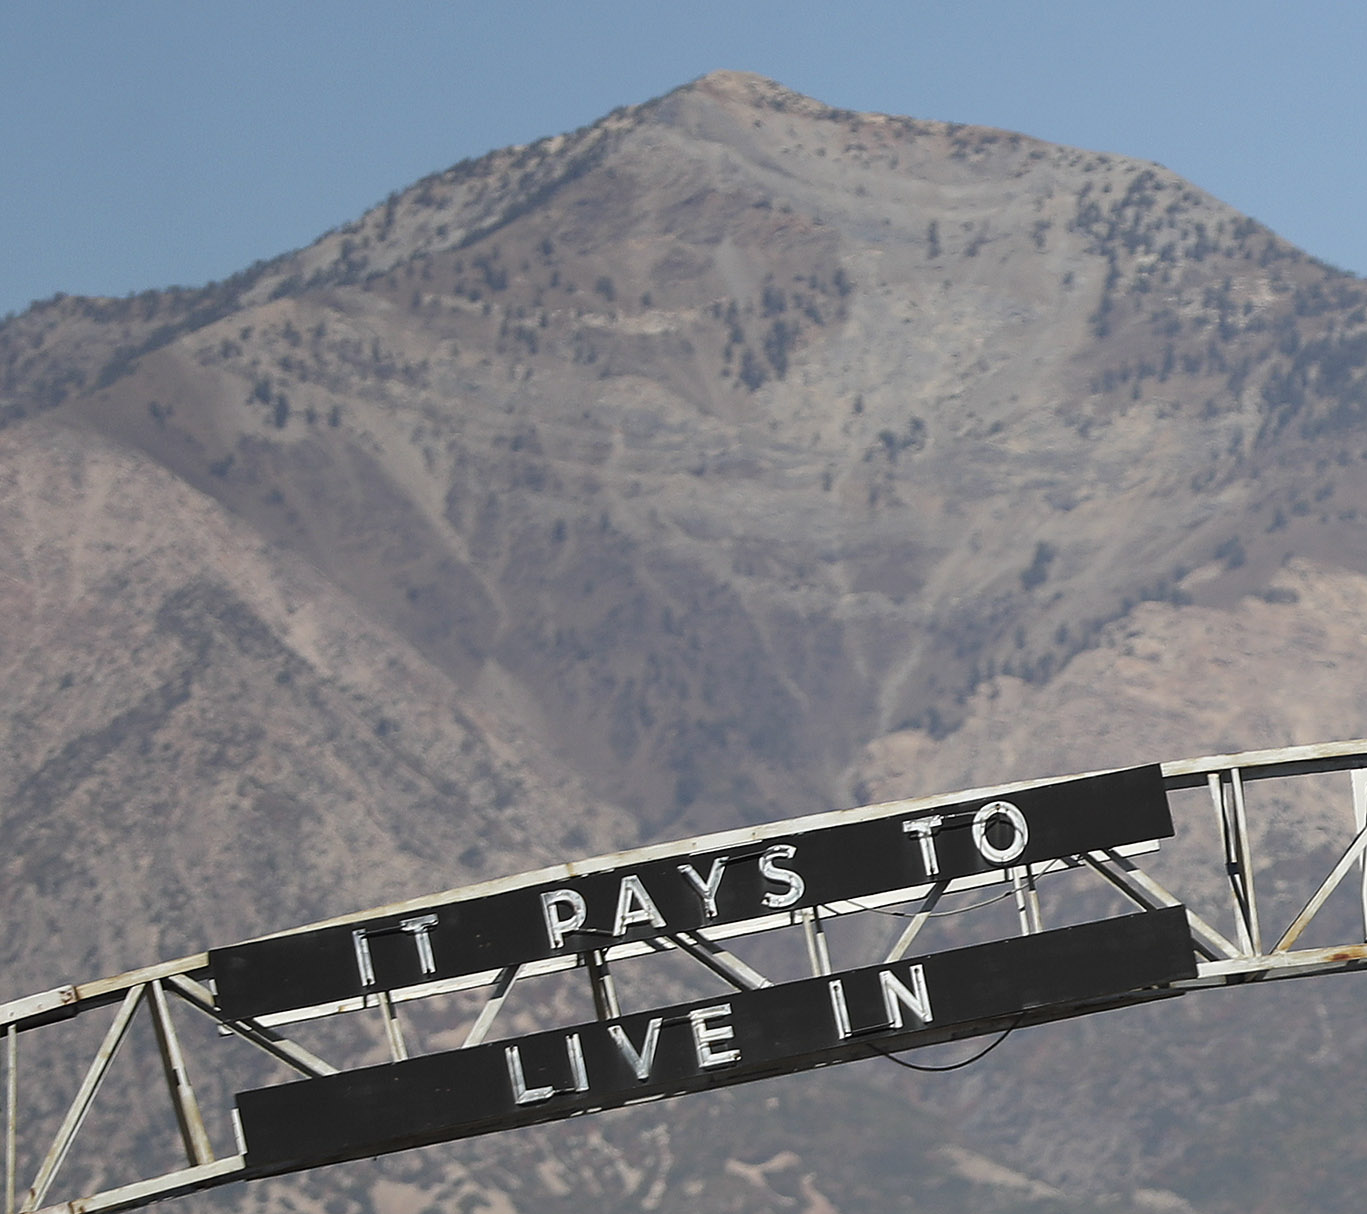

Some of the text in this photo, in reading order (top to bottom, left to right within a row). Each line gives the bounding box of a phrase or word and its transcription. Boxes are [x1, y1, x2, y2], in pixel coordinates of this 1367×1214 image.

[352, 801, 1029, 987] IT PAYS TO
[504, 963, 933, 1104] LIVE IN
